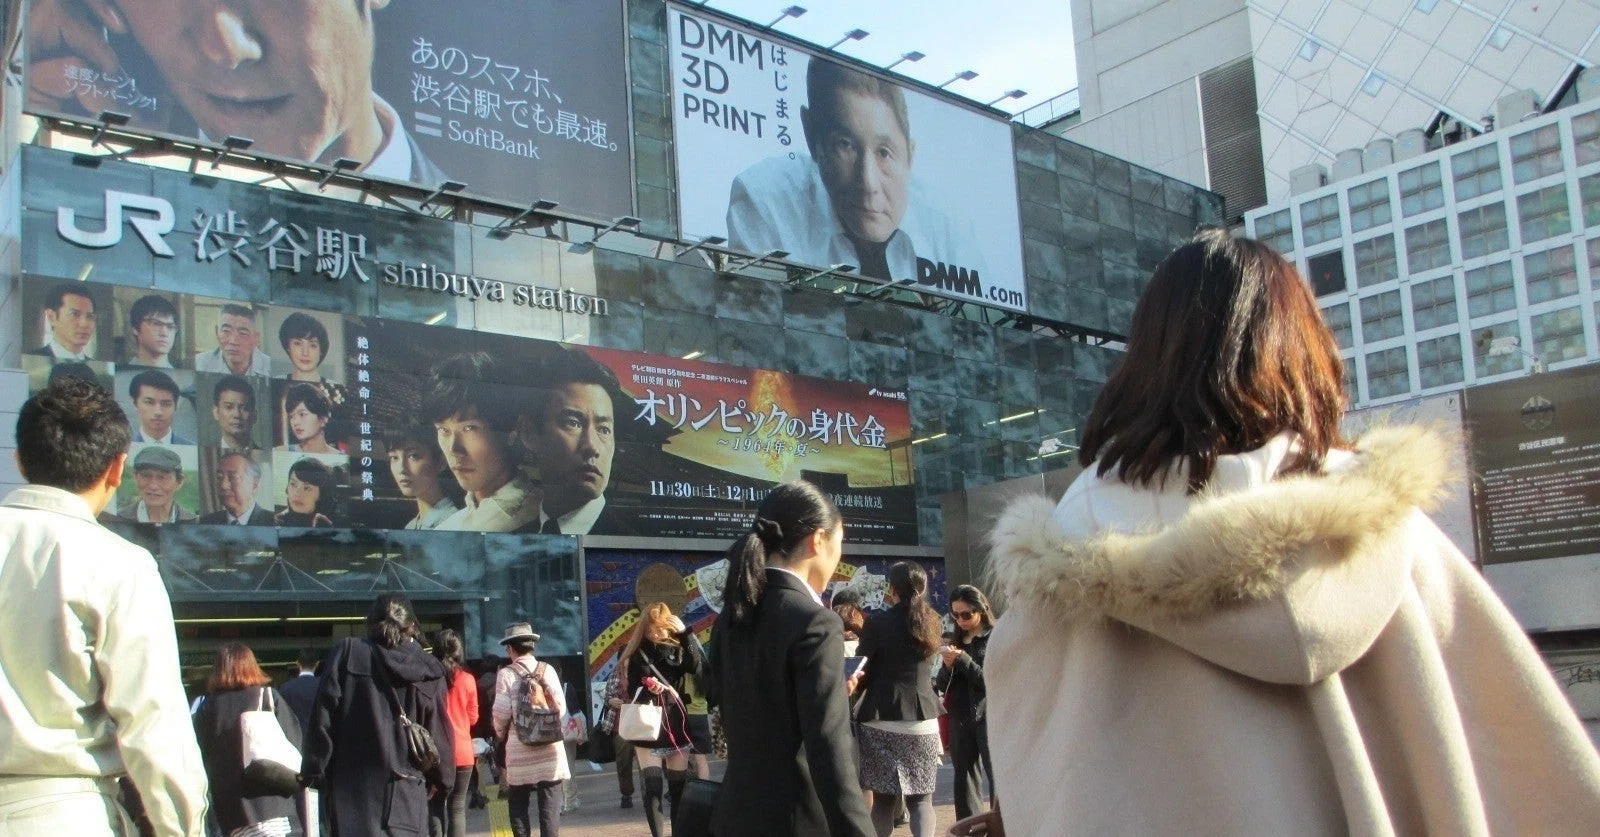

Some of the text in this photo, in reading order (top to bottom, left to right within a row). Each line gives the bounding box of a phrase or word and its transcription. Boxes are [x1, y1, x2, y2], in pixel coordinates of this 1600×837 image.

[411, 37, 562, 104] あのスマホ、
[679, 14, 764, 71] DMM
[681, 53, 730, 95] 3D
[771, 44, 796, 161] はじまる。
[411, 71, 618, 152] 渋谷駅でも最速。
[448, 120, 542, 160] SoftBank
[683, 93, 767, 139] PRINT
[57, 189, 371, 284] JR 渋谷駅
[383, 259, 609, 317] shibuya station
[633, 388, 888, 449] オリンピックの身代金
